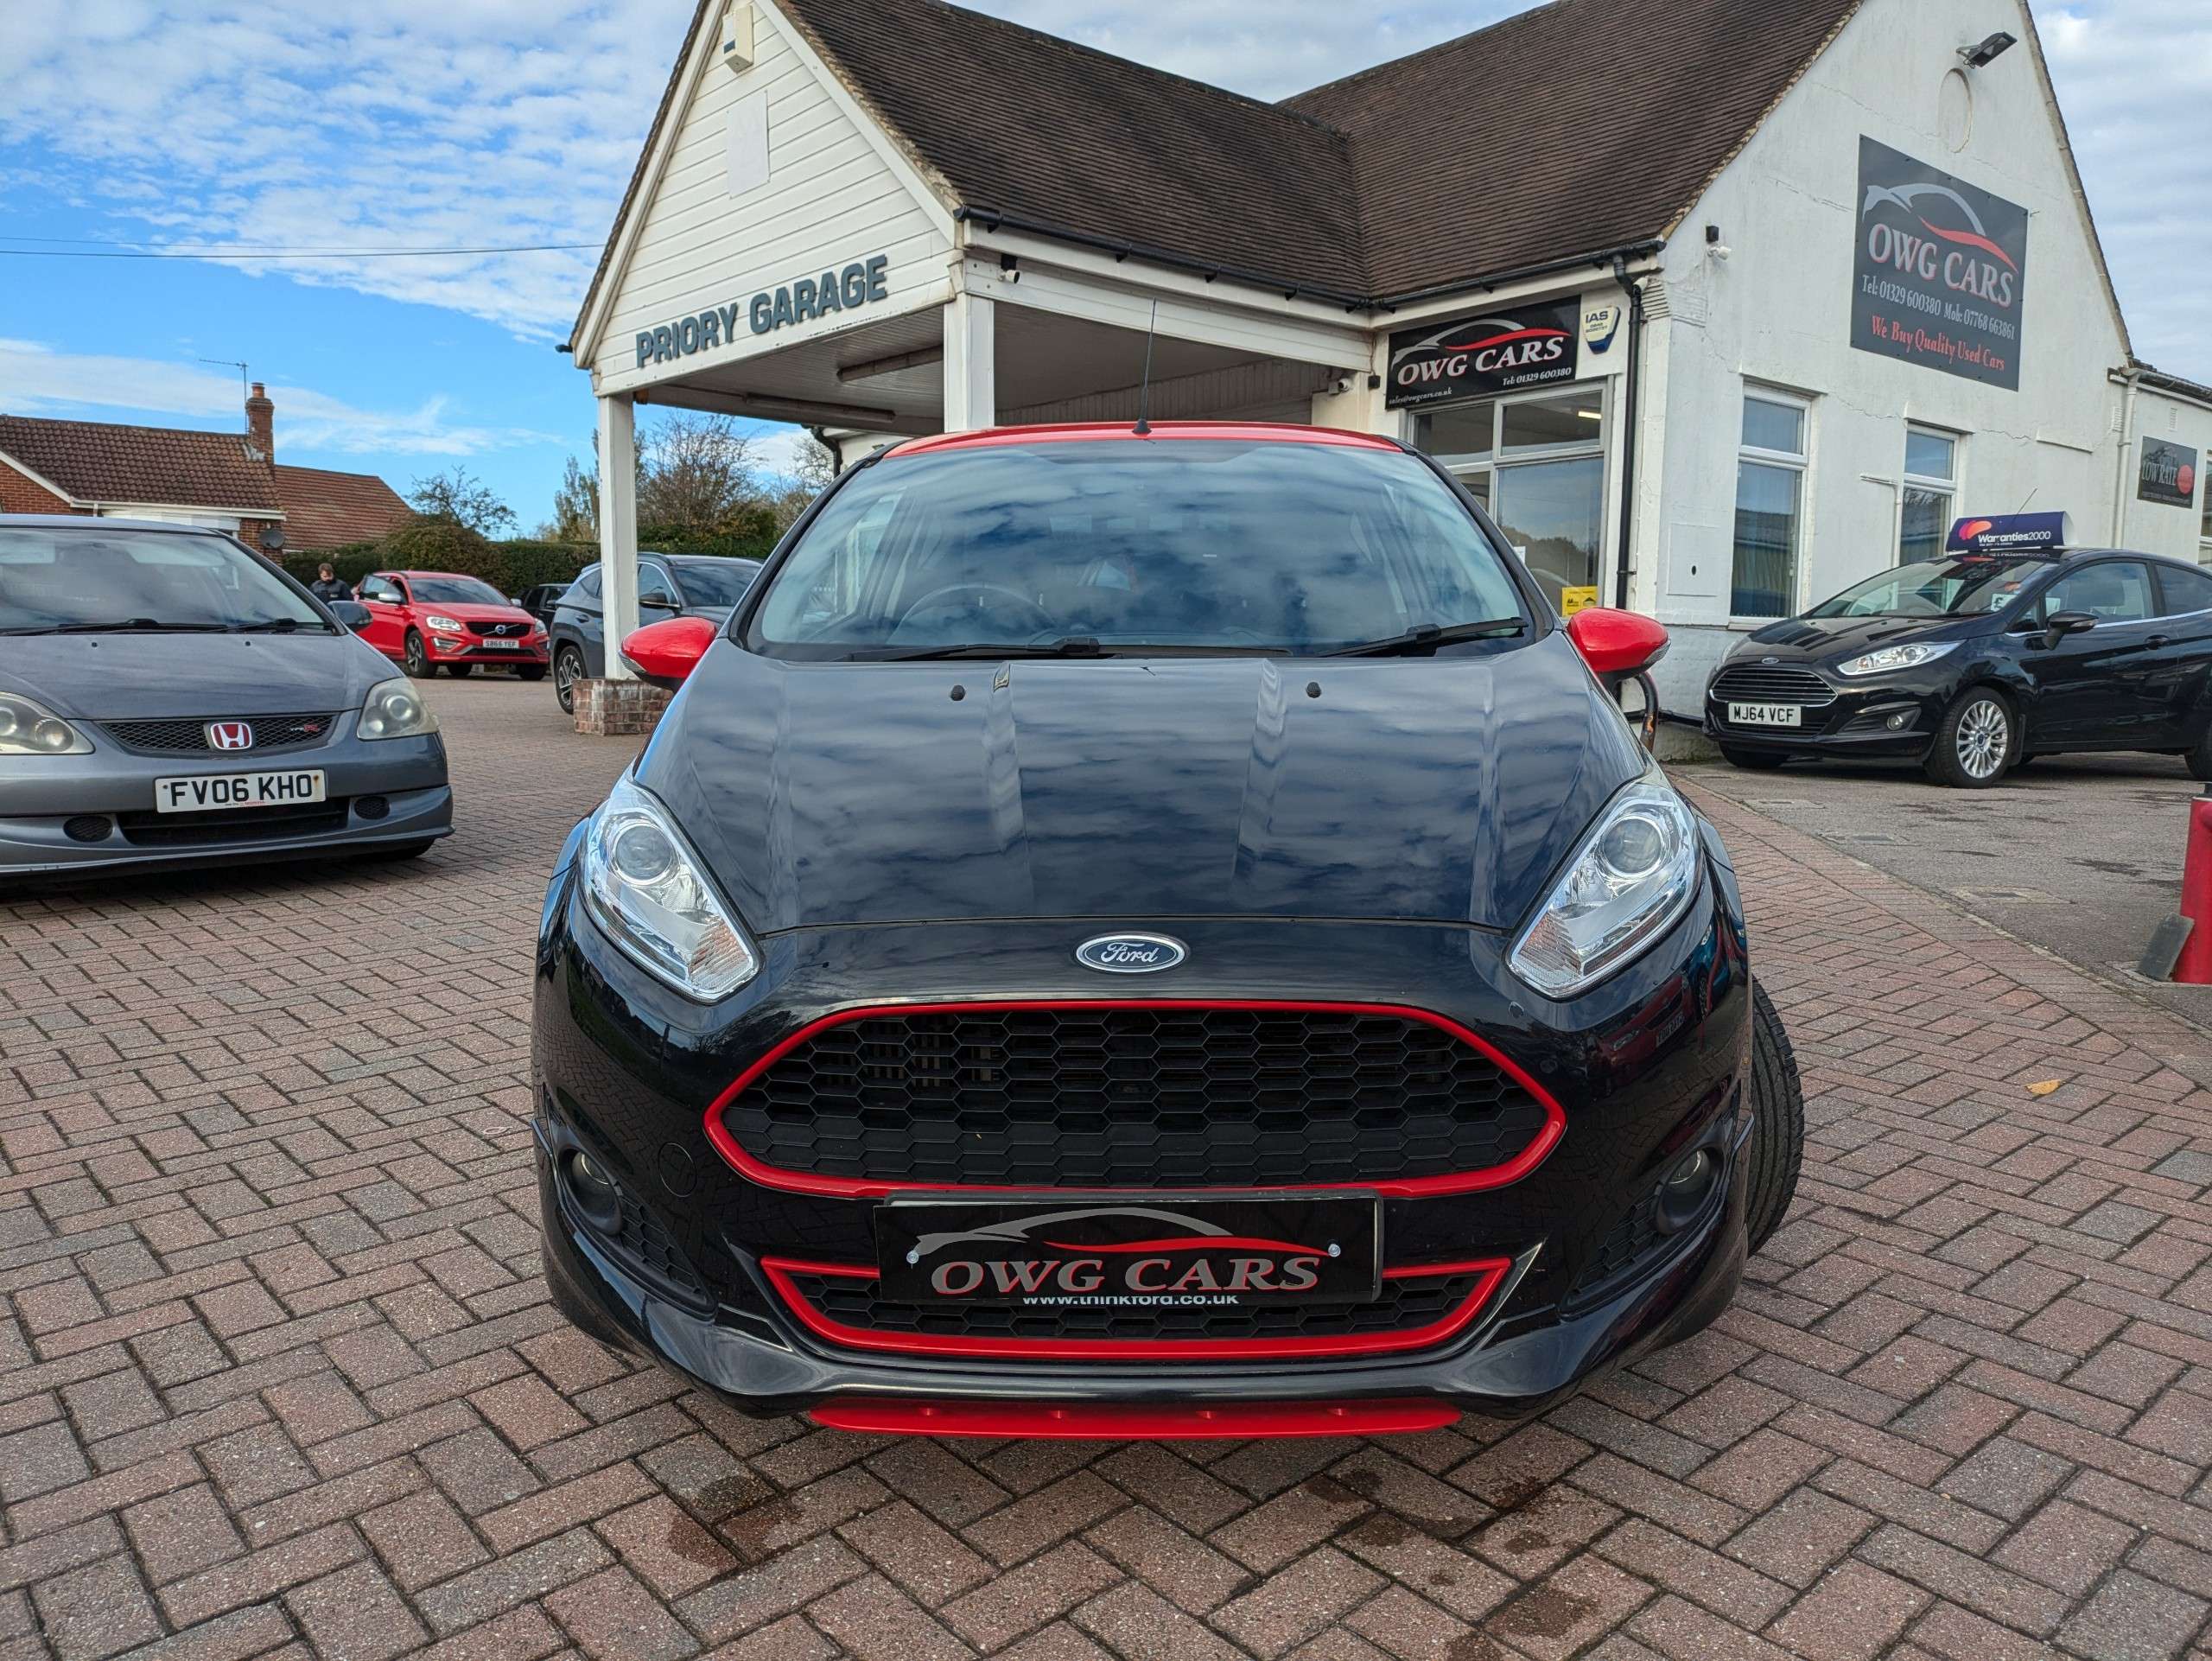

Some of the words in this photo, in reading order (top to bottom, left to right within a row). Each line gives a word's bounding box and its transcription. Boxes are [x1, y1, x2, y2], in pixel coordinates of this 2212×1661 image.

[1868, 223, 1937, 280] OWG
[1944, 251, 2013, 308] CARS
[635, 302, 738, 368] PRIORY
[750, 254, 888, 334] GARAGE
[1586, 311, 1608, 323] IAS
[1862, 274, 1878, 296] Tel:
[1879, 280, 1906, 305] 01329
[1907, 290, 1942, 316] 600380
[1943, 302, 1963, 323] Mob:
[1397, 353, 1468, 386] OWG
[1475, 336, 1565, 372] CARS
[1872, 315, 1888, 339] We
[1891, 321, 1914, 353] Buy
[1915, 328, 1956, 365] Quality
[1957, 340, 1981, 364] Used
[1983, 348, 2005, 372] Cars
[1516, 372, 1539, 385] 01329
[1540, 366, 1572, 379] 600380
[1733, 705, 1765, 721] MJ64
[1768, 706, 1795, 722] VCF
[169, 778, 250, 807] FV06
[257, 773, 313, 800] KHO
[1100, 942, 1160, 963] Ford
[931, 1258, 1105, 1295] OWG
[1123, 1257, 1320, 1292] CARS
